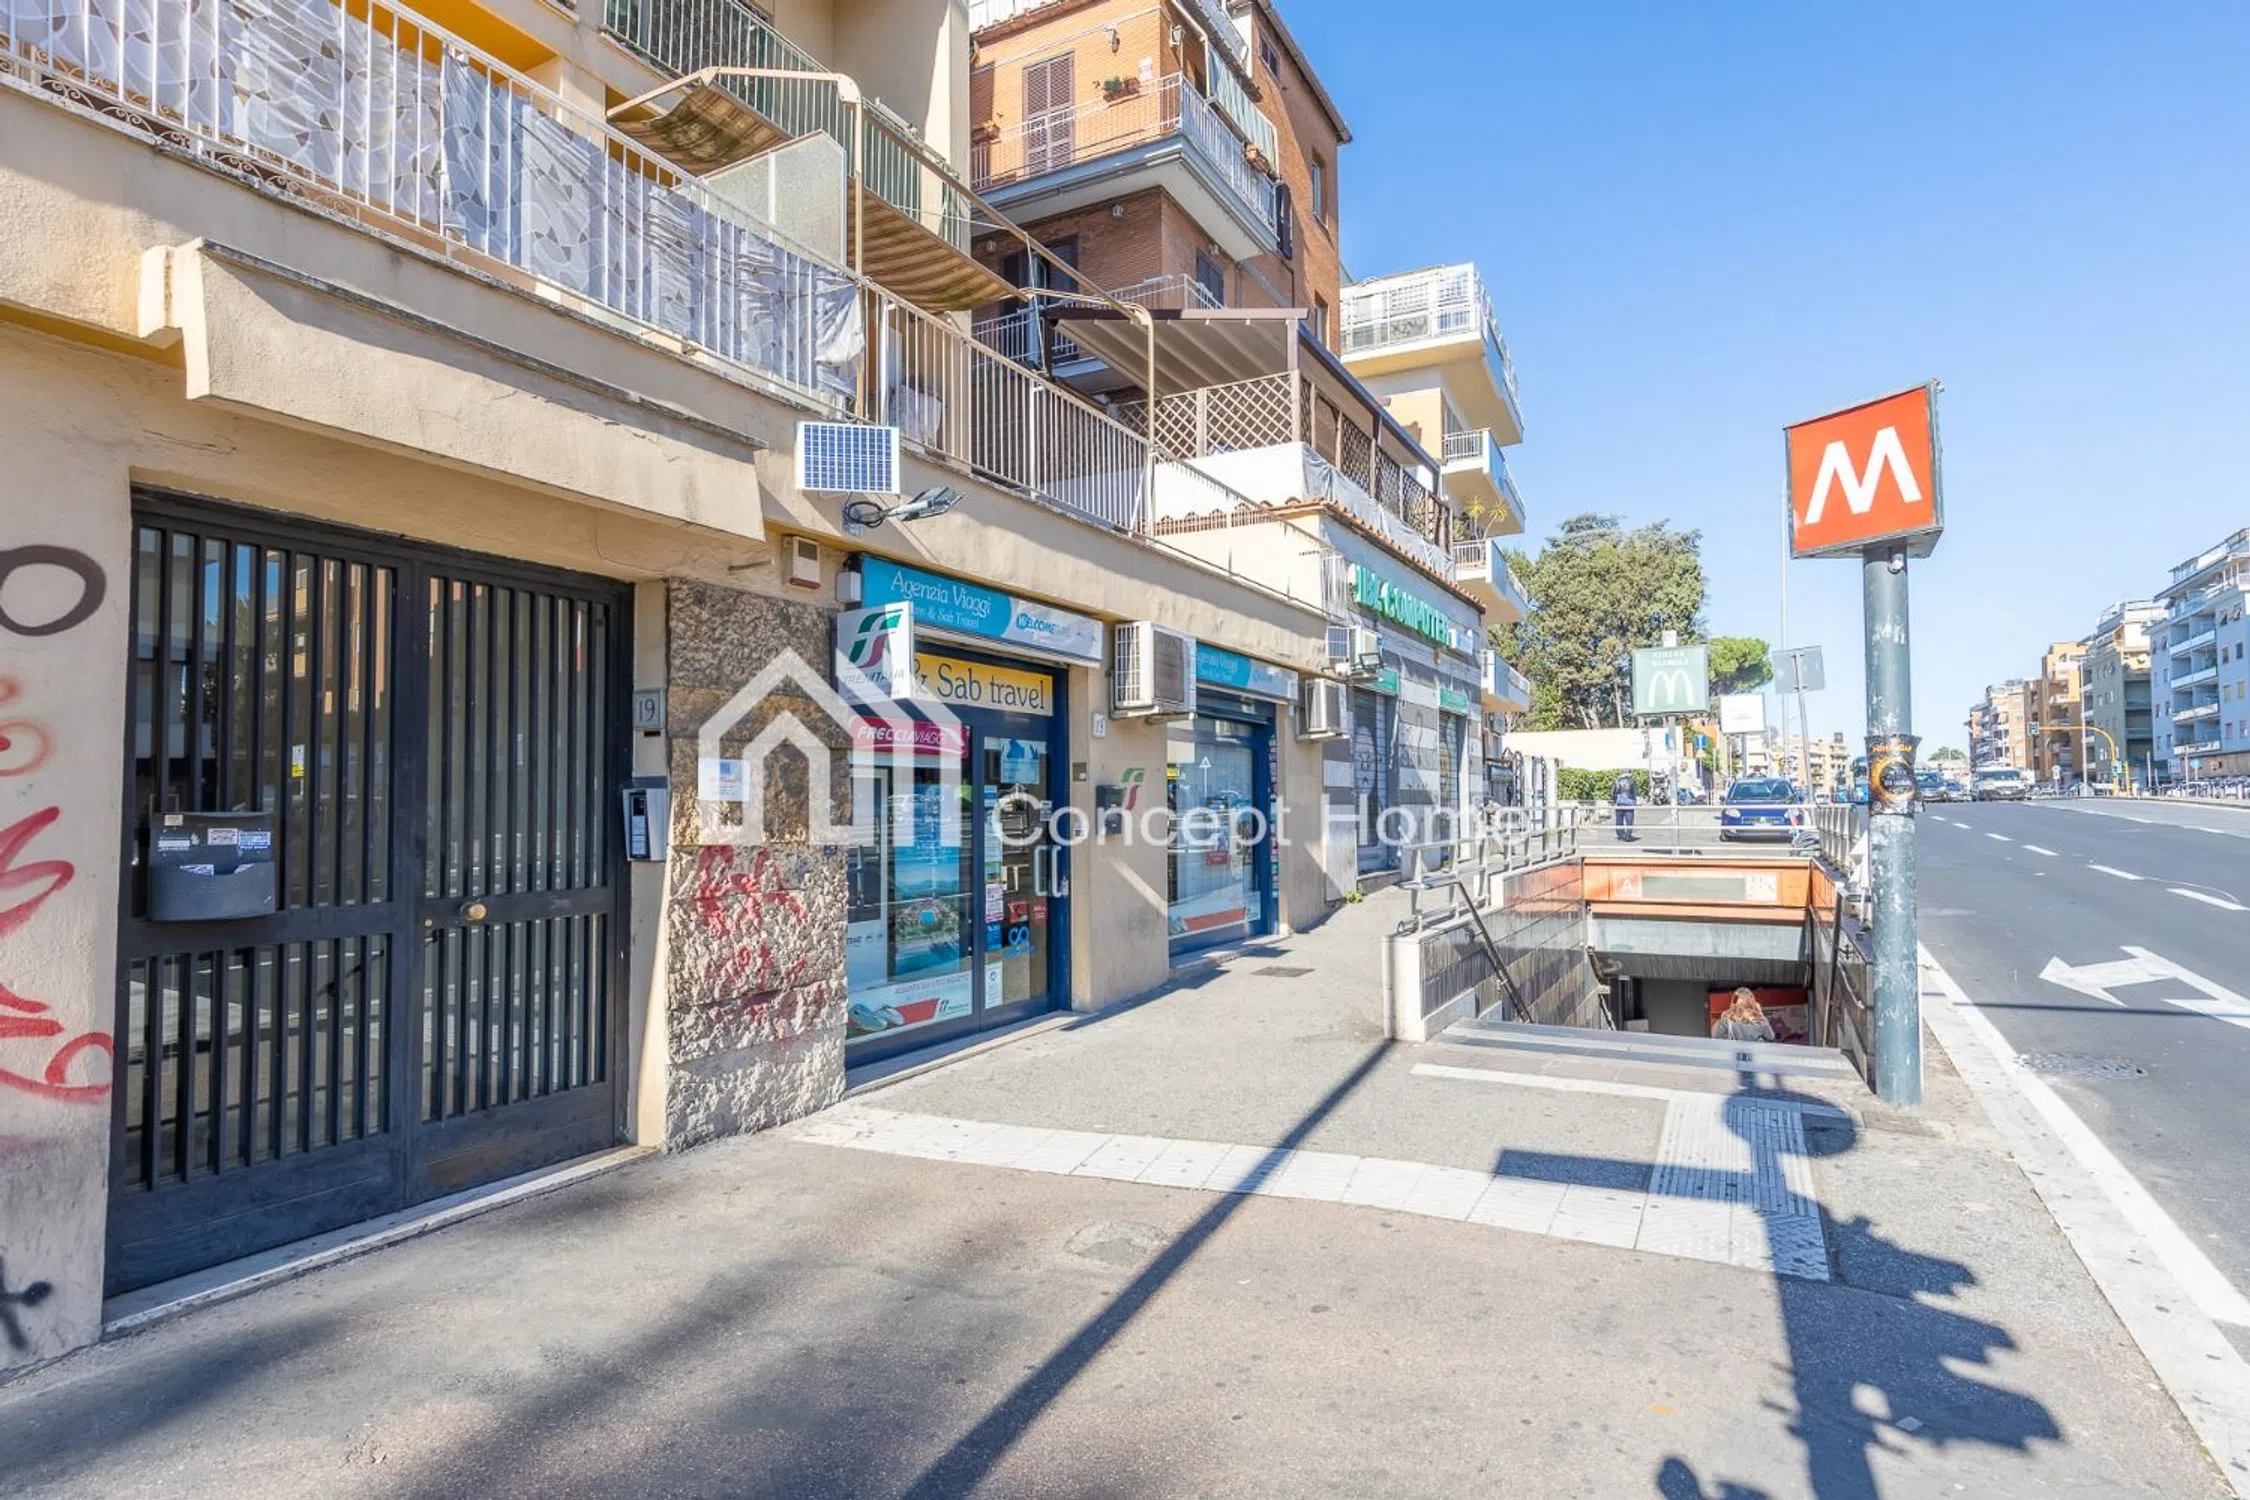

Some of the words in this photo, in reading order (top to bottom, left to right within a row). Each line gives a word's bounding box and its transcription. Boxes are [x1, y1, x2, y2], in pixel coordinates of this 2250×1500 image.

[1804, 426, 1923, 525] M
[891, 571, 948, 600] Agenzia
[953, 586, 991, 617] Viaggi
[937, 663, 983, 700] Sab
[989, 675, 1046, 710] travel
[638, 698, 656, 722] 19
